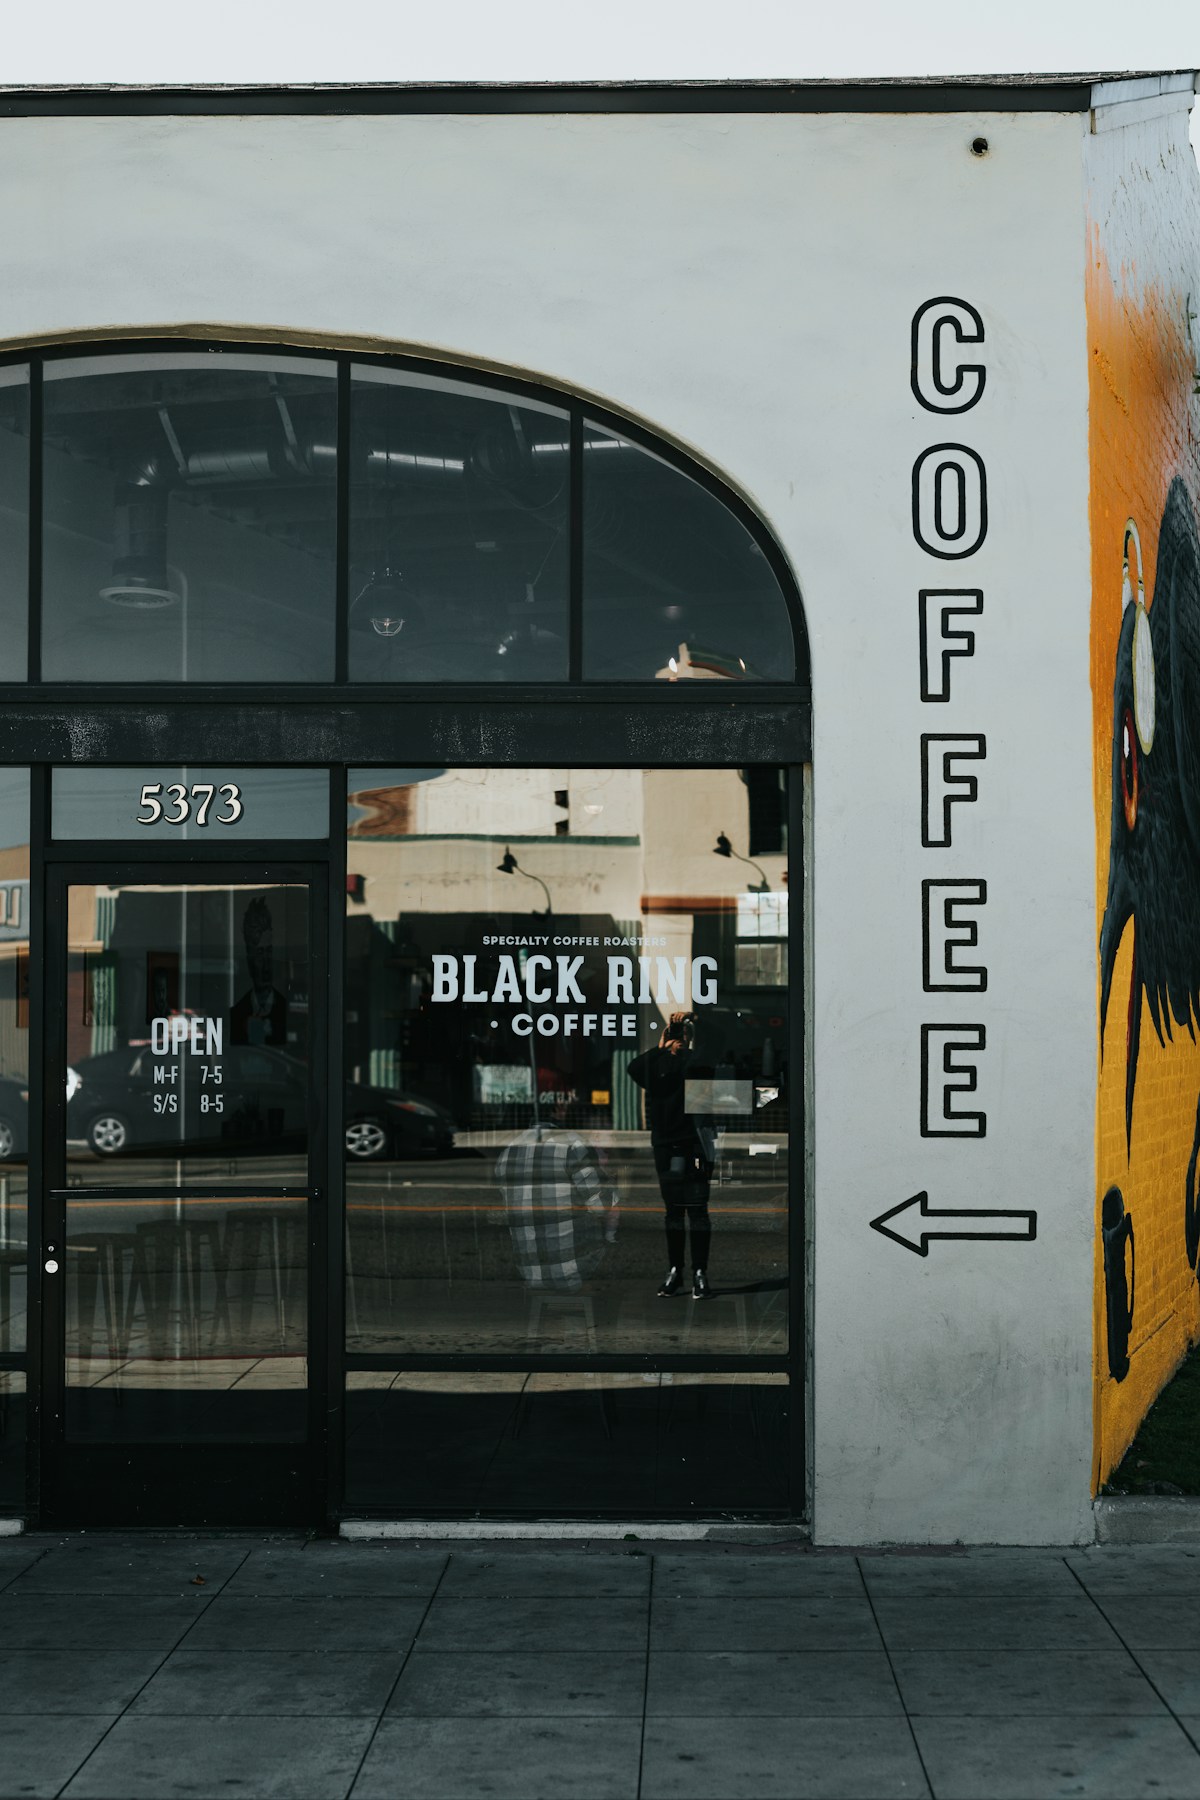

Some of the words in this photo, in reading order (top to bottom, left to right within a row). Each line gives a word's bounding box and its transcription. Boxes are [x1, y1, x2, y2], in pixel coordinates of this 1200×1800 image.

[911, 296, 988, 1139] COFFEE
[136, 783, 244, 827] 5373
[482, 935, 549, 946] SPECIALTY
[552, 936, 599, 946] COFFEE
[603, 936, 666, 947] ROASTERS
[431, 954, 587, 1003] BLACK
[606, 955, 718, 1005] RING
[151, 1017, 223, 1056] OPEN
[511, 1013, 637, 1037] COFFEE
[153, 1065, 179, 1085] M-F
[200, 1065, 223, 1085] 7-5
[153, 1093, 178, 1114] S/S
[200, 1094, 224, 1114] 8-5
